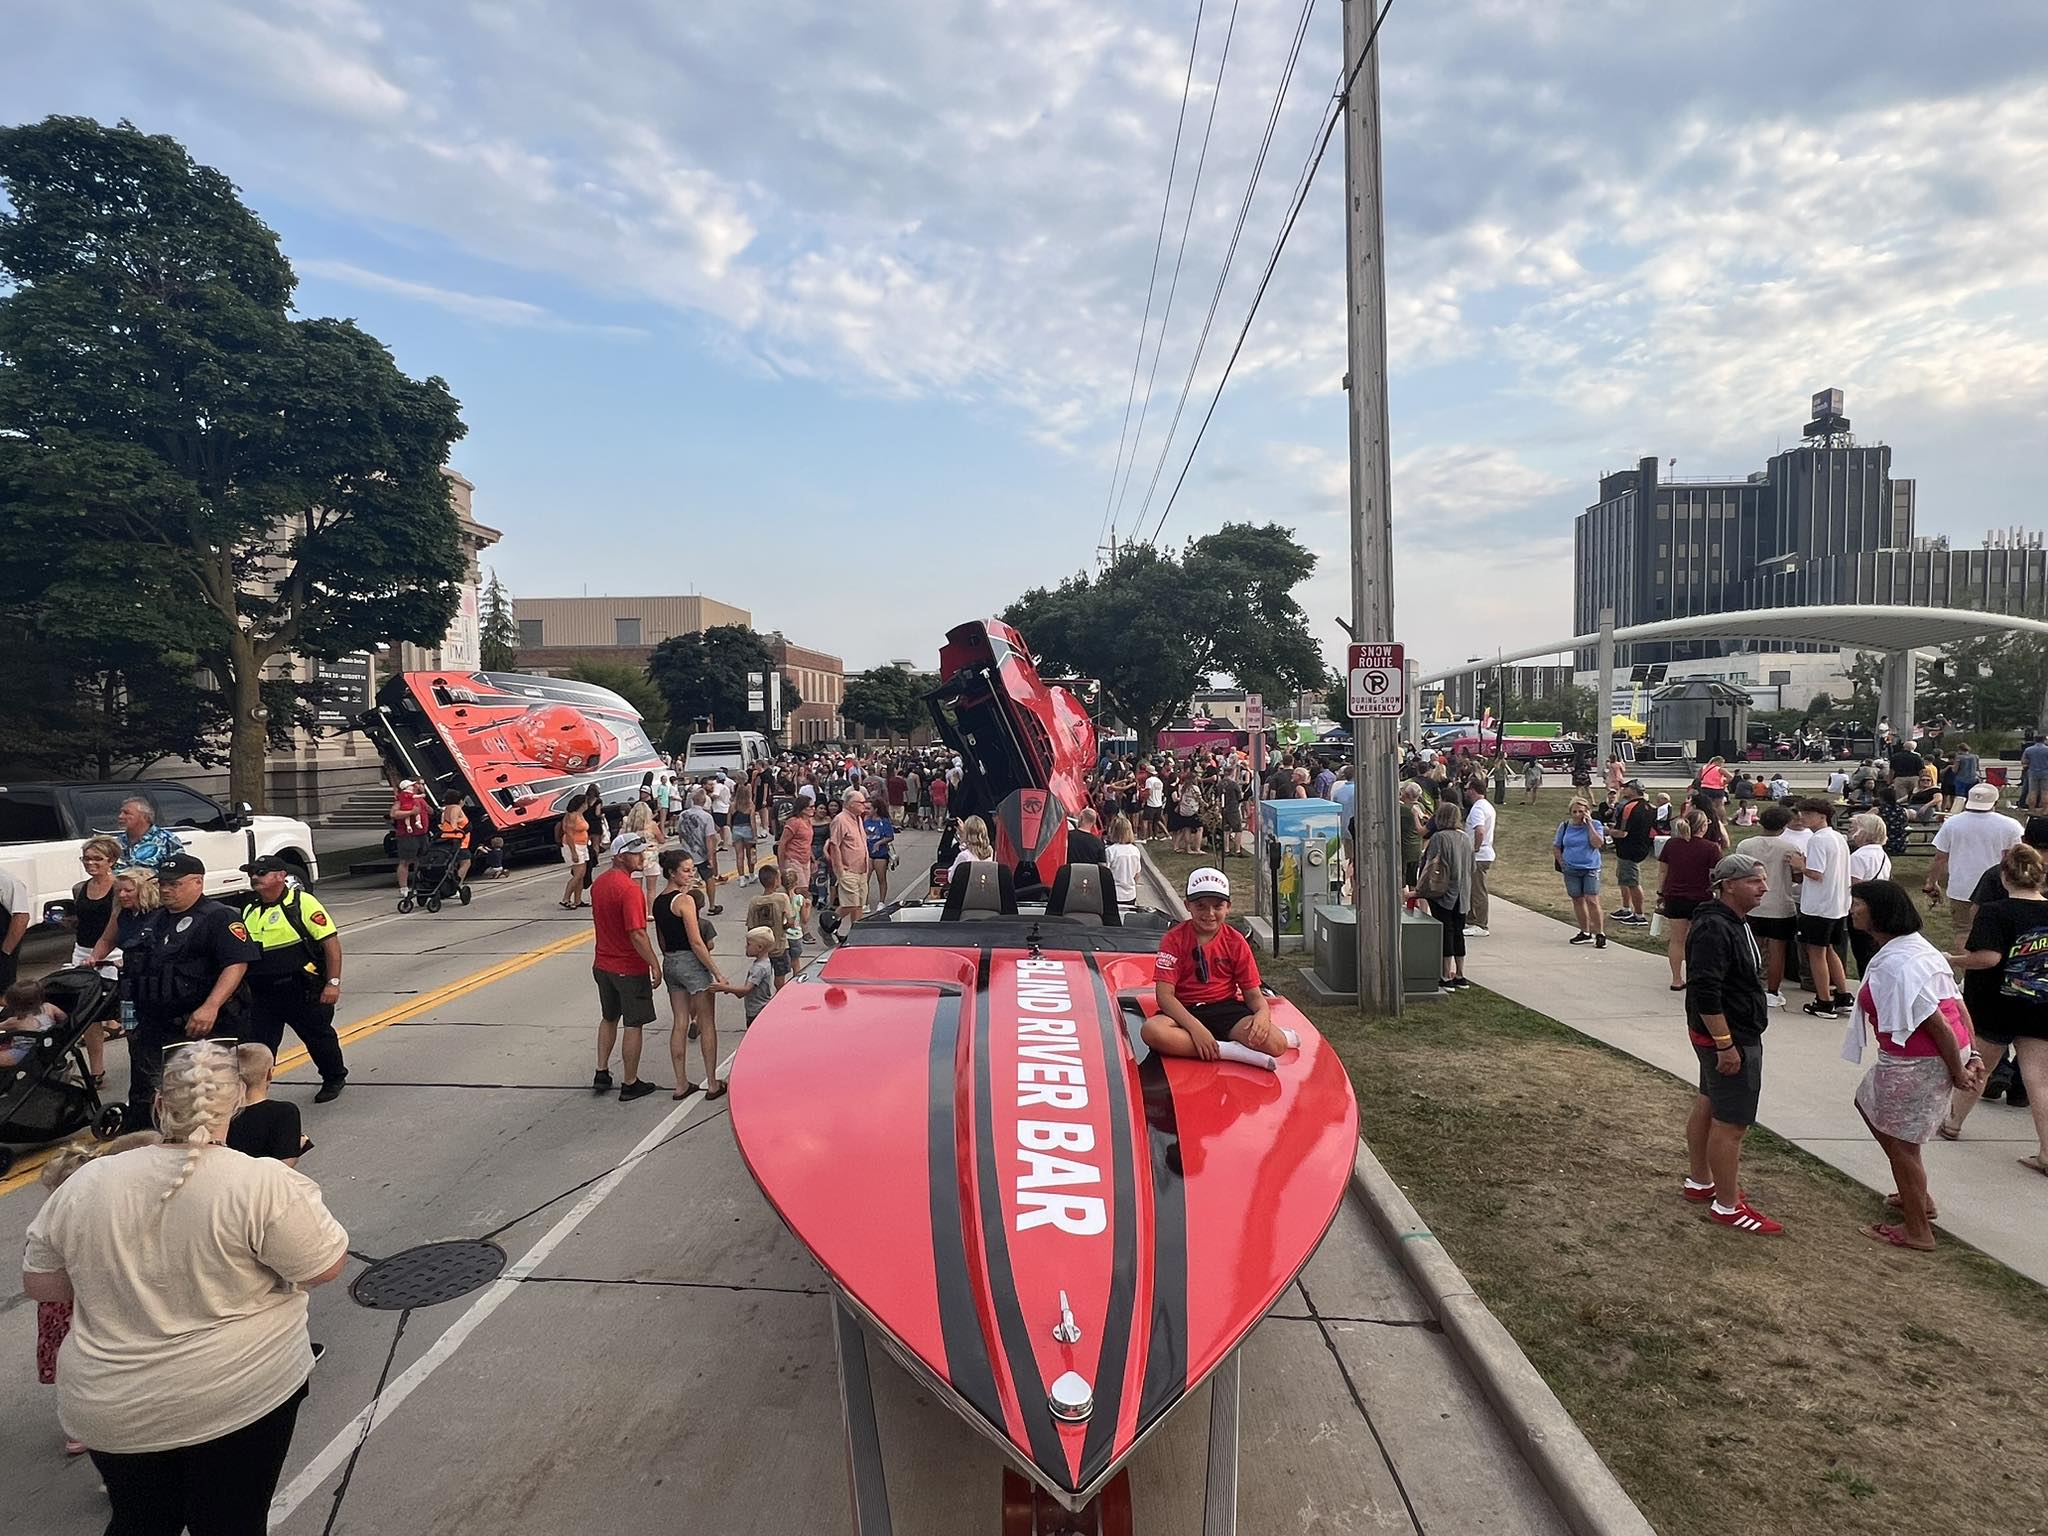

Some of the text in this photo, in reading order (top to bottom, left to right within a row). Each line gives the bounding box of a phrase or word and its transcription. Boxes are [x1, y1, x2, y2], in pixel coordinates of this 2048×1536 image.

[1360, 646, 1392, 657] SNOW
[1359, 657, 1393, 668] ROUTE
[1355, 704, 1397, 712] EMERGENCY
[1015, 959, 1107, 1236] BLIND RIVER BAR
